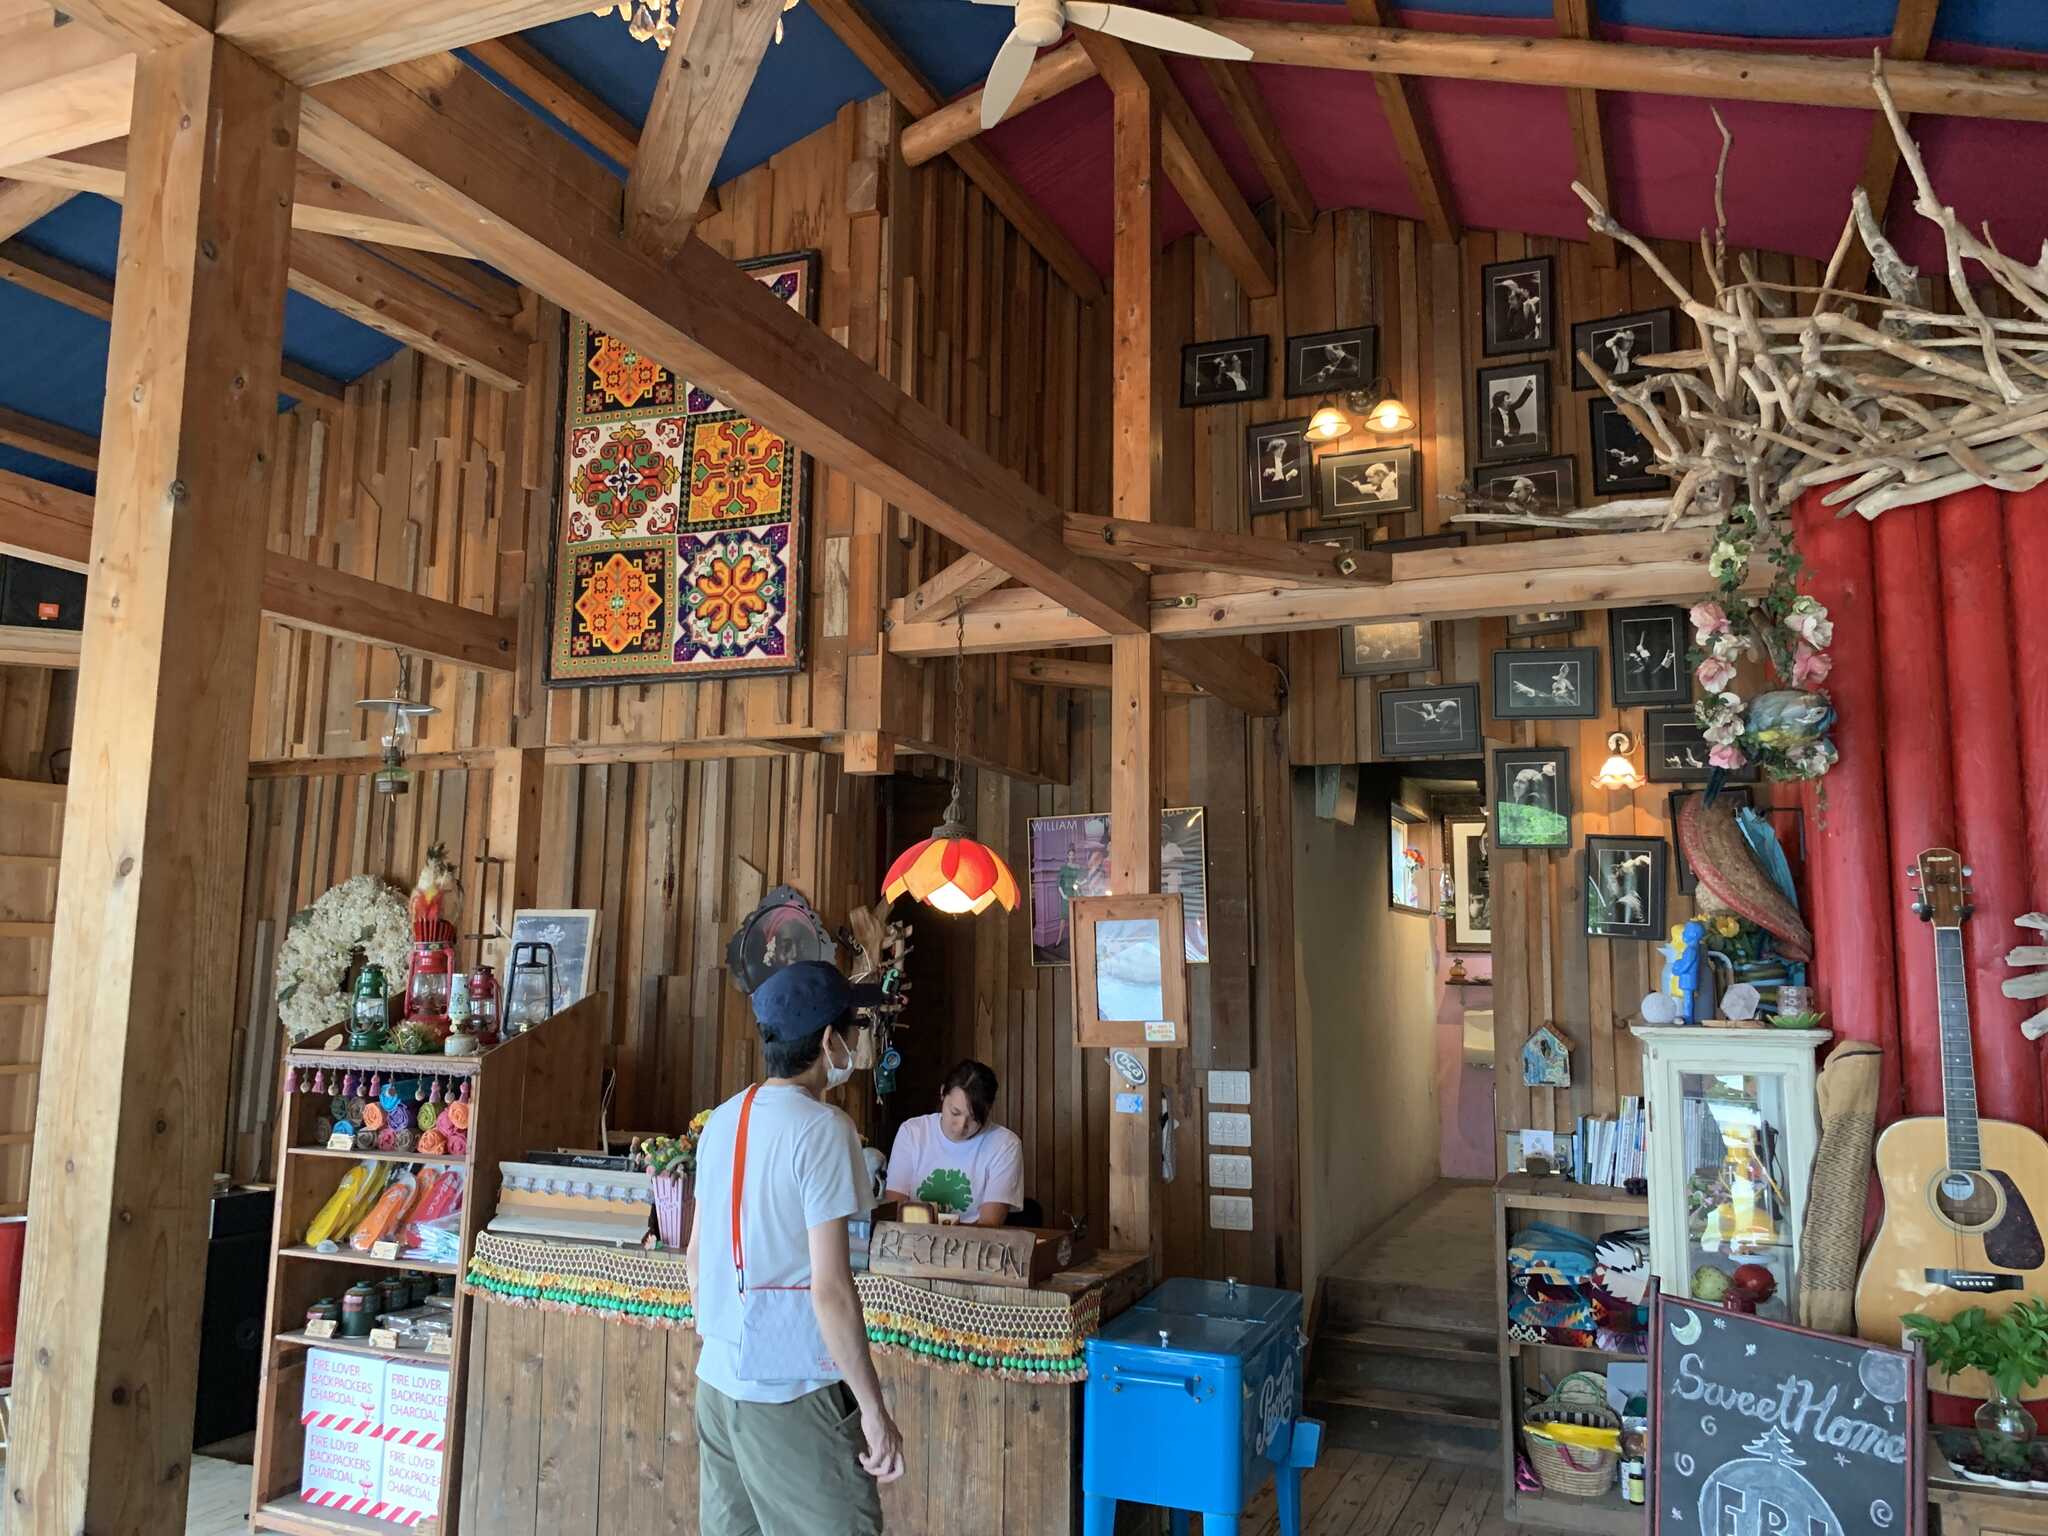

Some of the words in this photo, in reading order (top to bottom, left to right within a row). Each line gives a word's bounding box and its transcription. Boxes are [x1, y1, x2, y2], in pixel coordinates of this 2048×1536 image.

[1031, 819, 1078, 832] WILLIAM
[312, 1358, 329, 1372] FIRE
[331, 1363, 361, 1376] LOVER
[311, 1375, 373, 1394] BACKPACKERS
[391, 1373, 409, 1387] FIRE
[411, 1376, 442, 1391] LOVER
[310, 1387, 357, 1407] CHARCOAL
[390, 1404, 439, 1422] CHARCOAL
[1671, 1353, 1798, 1430] Sweet
[1792, 1379, 1907, 1464] Home
[311, 1434, 328, 1448] FIRE
[330, 1439, 359, 1453] LOVER
[309, 1450, 371, 1472] BACKPACKERS
[389, 1450, 406, 1465] FIRE
[408, 1454, 435, 1469] LOVER
[308, 1464, 355, 1484] CHARCOAL
[386, 1480, 433, 1501] CHARCOAL
